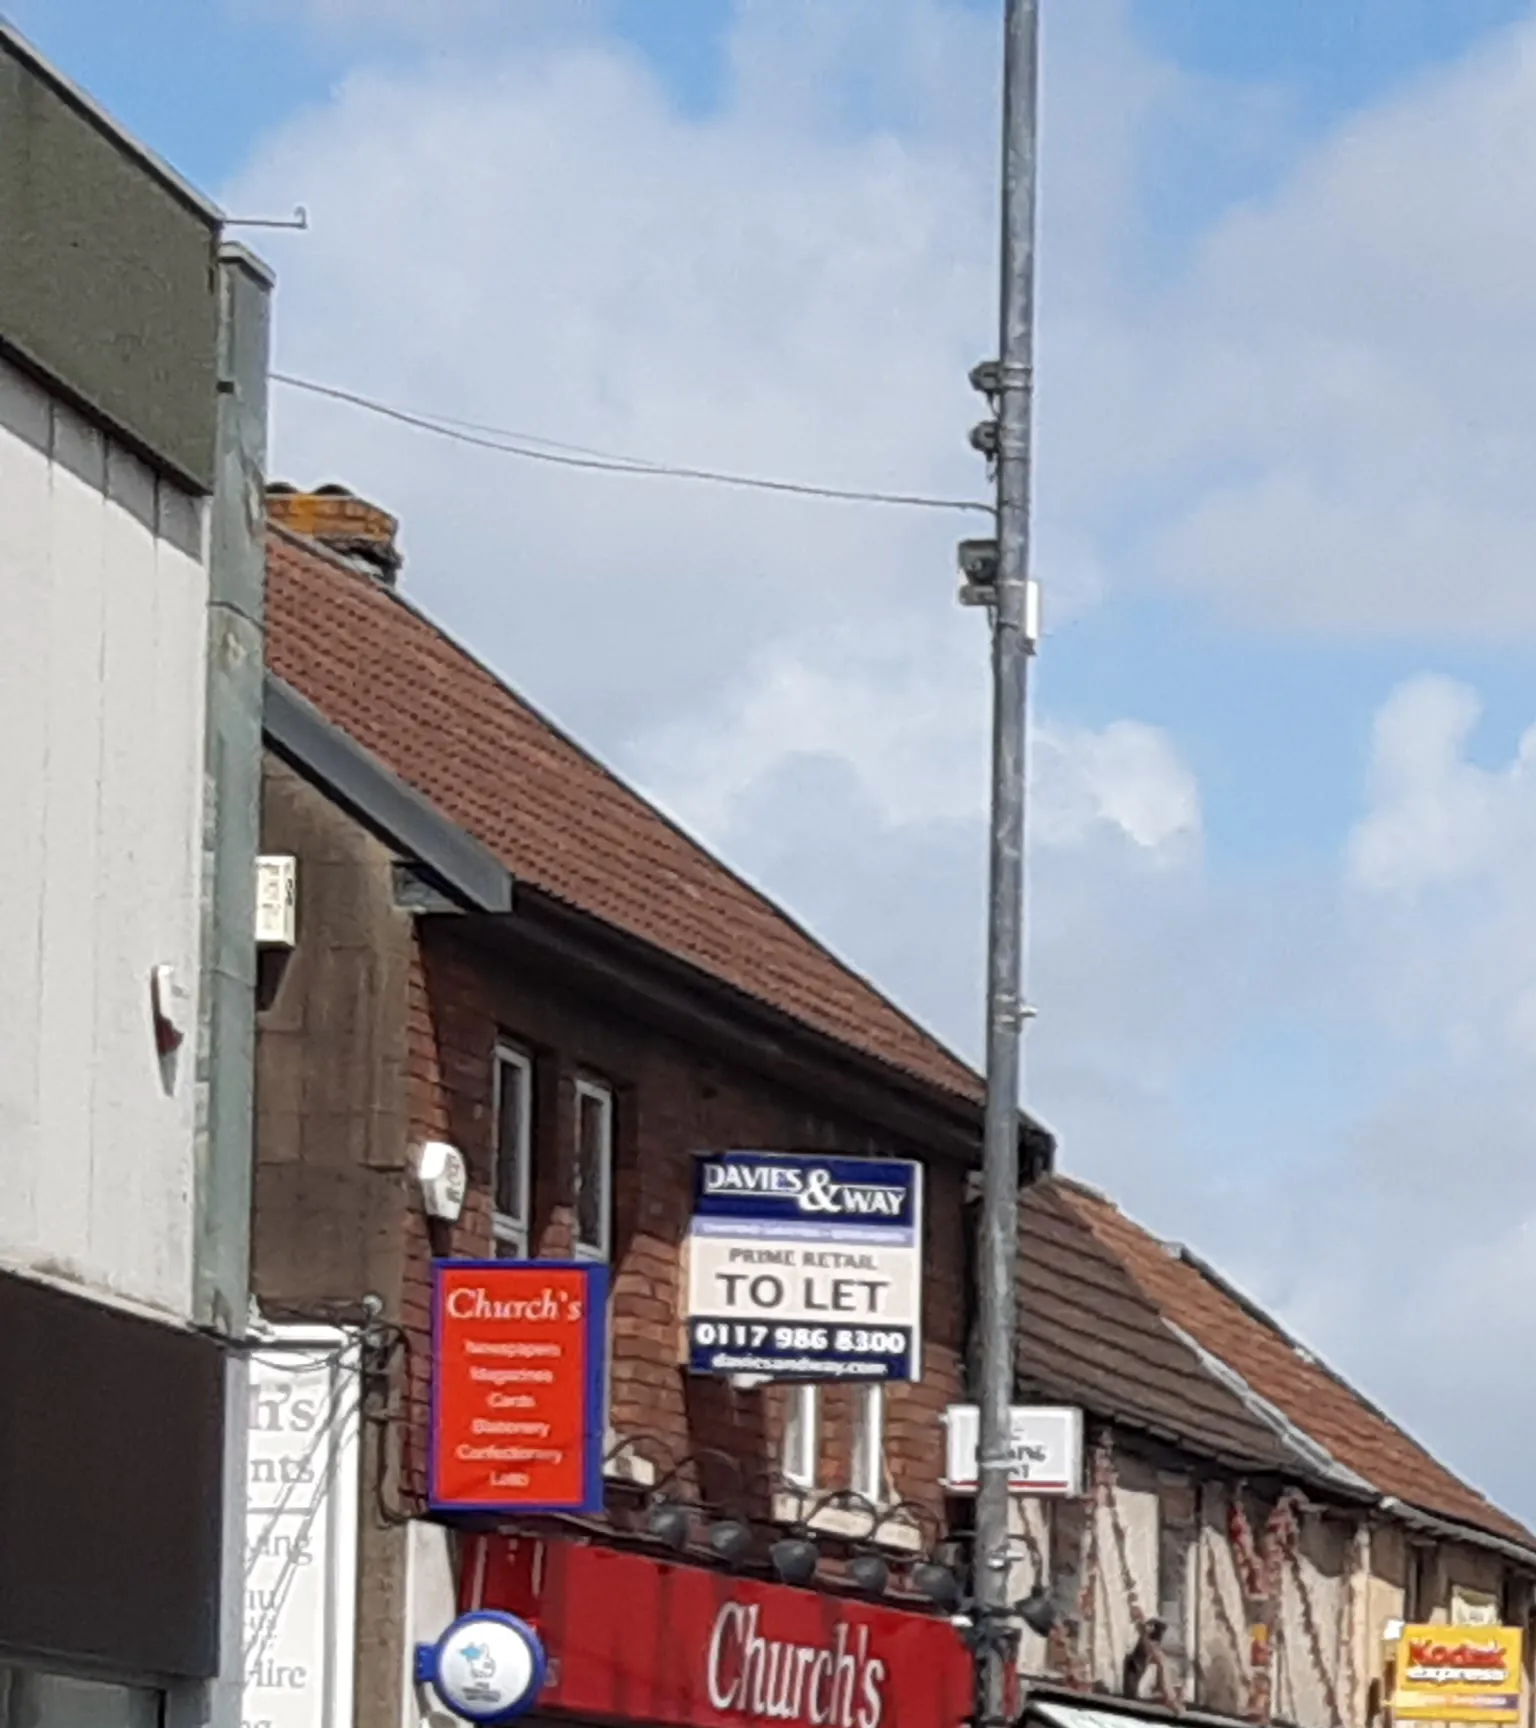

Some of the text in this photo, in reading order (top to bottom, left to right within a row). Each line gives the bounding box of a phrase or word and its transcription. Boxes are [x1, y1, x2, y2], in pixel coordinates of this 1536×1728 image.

[446, 1286, 582, 1323] Church's
[715, 1271, 890, 1314] TO LET
[695, 1322, 907, 1354] 0117 986 8300
